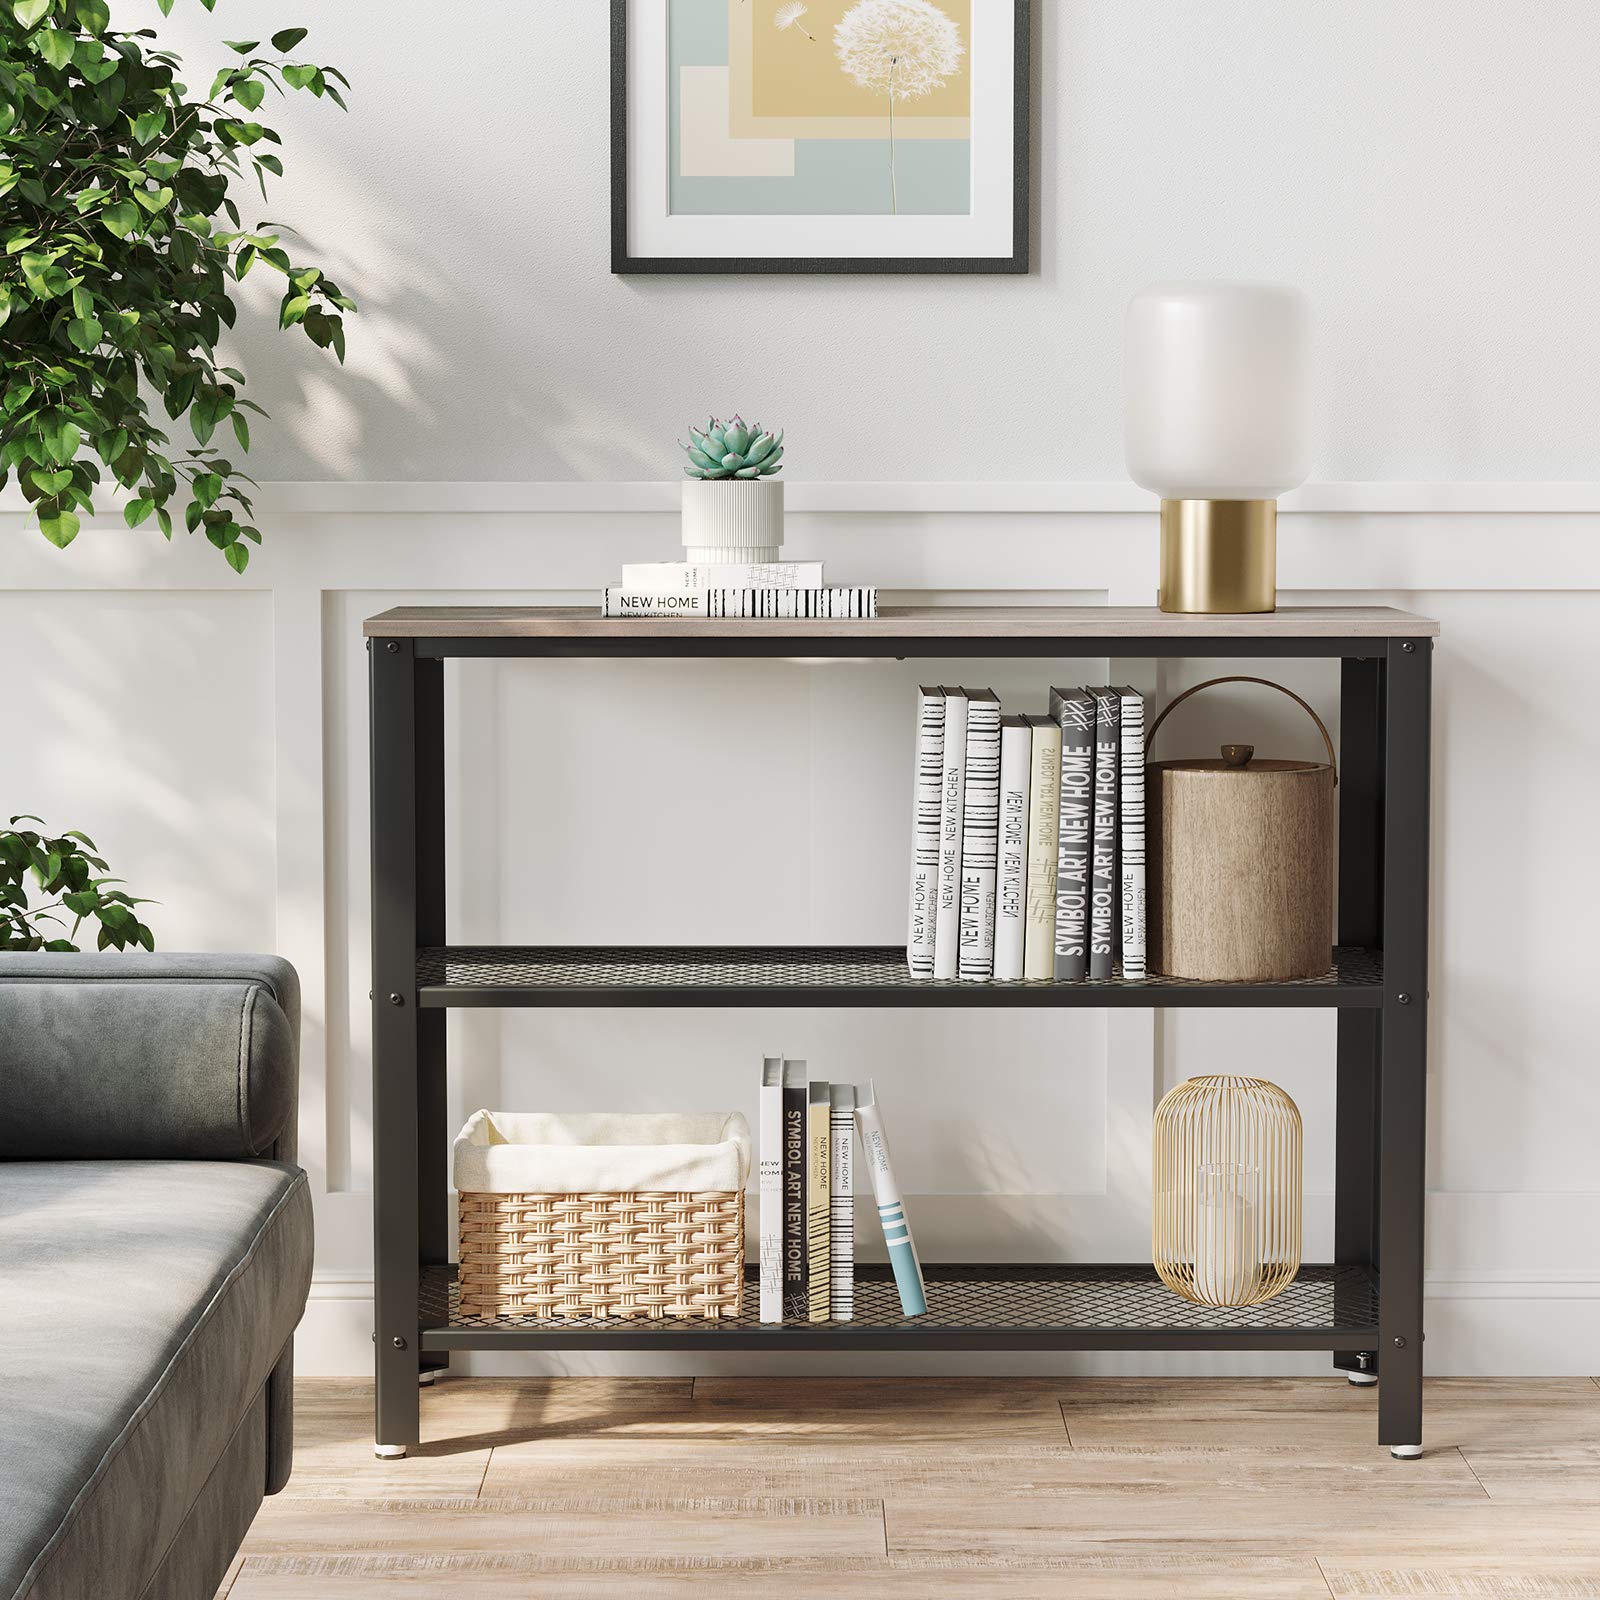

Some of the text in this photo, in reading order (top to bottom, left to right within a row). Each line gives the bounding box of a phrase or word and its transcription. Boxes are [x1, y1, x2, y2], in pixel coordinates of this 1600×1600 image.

[620, 596, 699, 608] NEW HOME
[942, 767, 959, 909] NEW HOME NEW KITCHEN
[1055, 746, 1091, 956] SYMBOL ART NEW HOME
[1091, 742, 1116, 954] SYMBOL ART NEW HOME
[913, 873, 926, 945] NEW HOME
[927, 888, 938, 945] NEW KITCHEN
[961, 876, 981, 947] NEW HOME
[984, 890, 995, 948] NEW KITCHEN
[1123, 873, 1134, 944] NEW HOME
[1137, 887, 1146, 945] NEW KITCHEN
[871, 1130, 888, 1172] NEW HOME
[787, 1110, 801, 1281] SYMBOL ART NEW HOME
